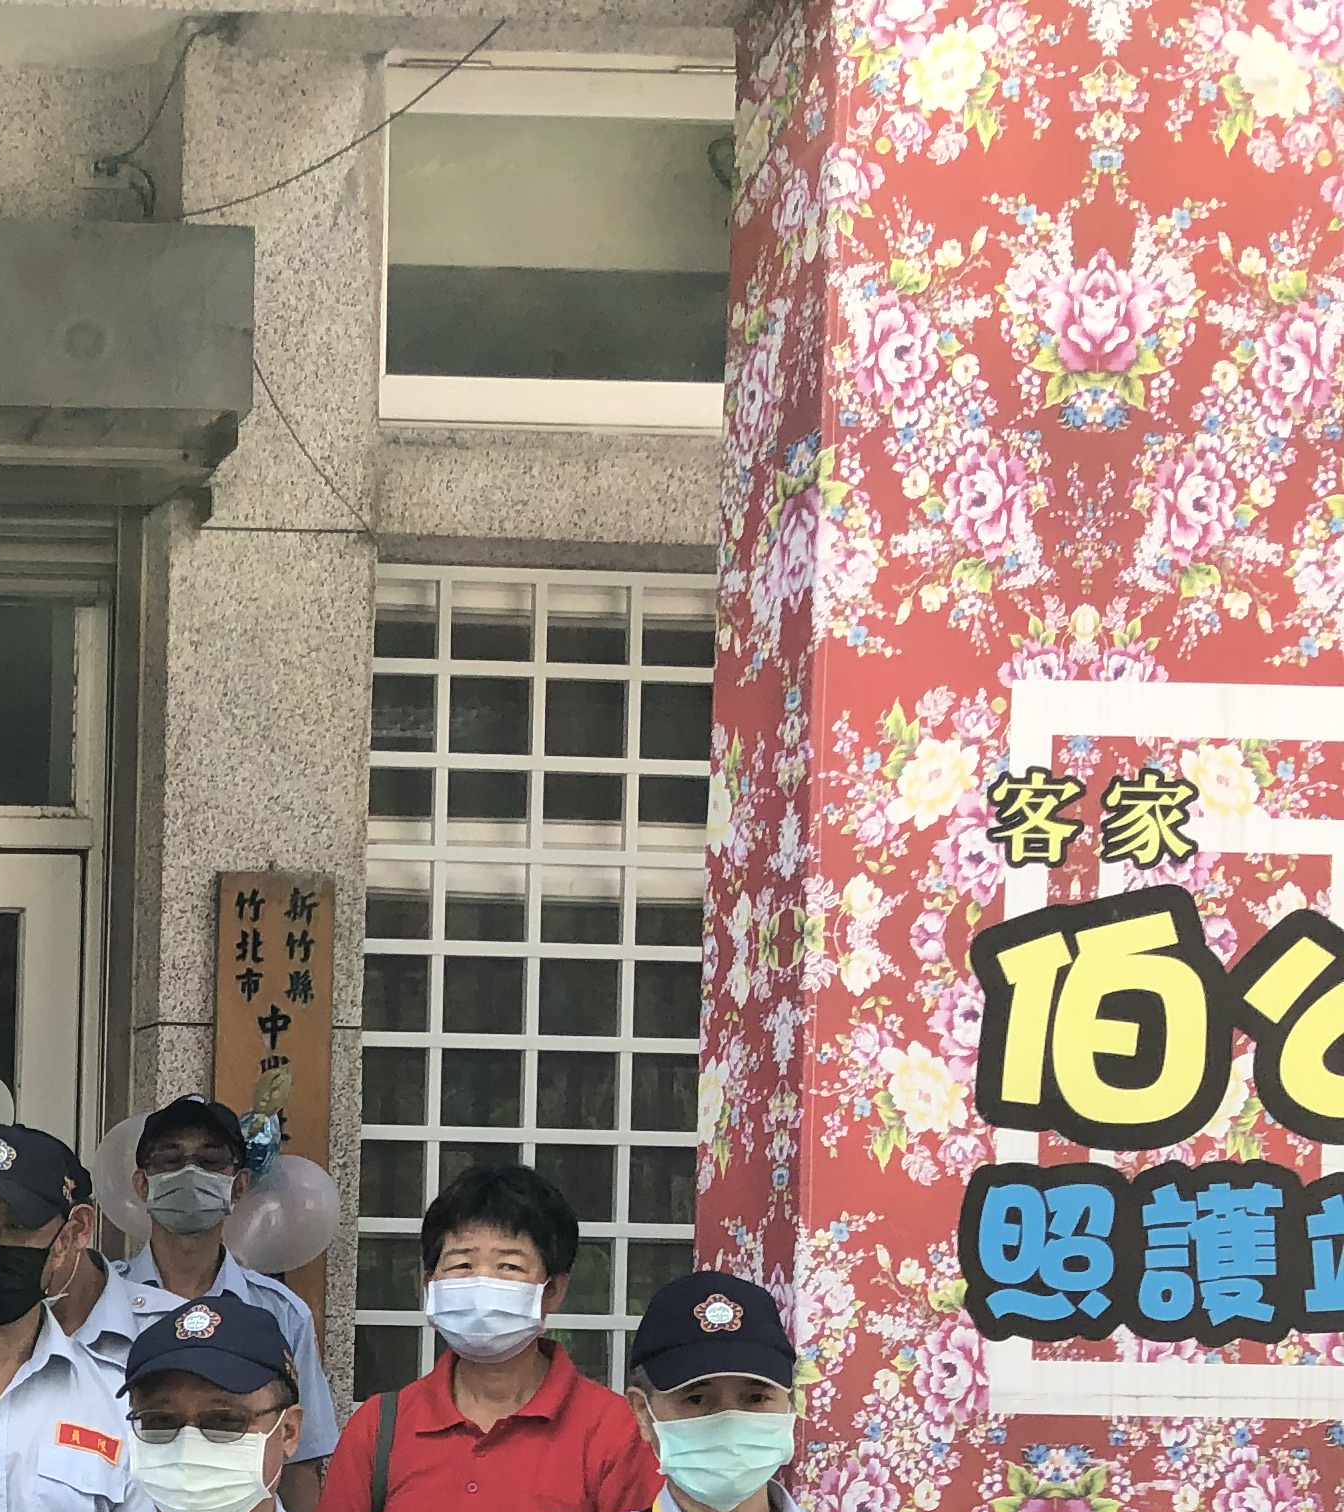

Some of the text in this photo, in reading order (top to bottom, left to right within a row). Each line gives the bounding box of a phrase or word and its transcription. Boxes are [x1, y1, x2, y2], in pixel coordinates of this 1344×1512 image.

[989, 770, 1198, 866] 客家
[235, 888, 266, 1002] 竹北市
[284, 887, 319, 1005] 新竹縣
[974, 1178, 1344, 1328] 照護
